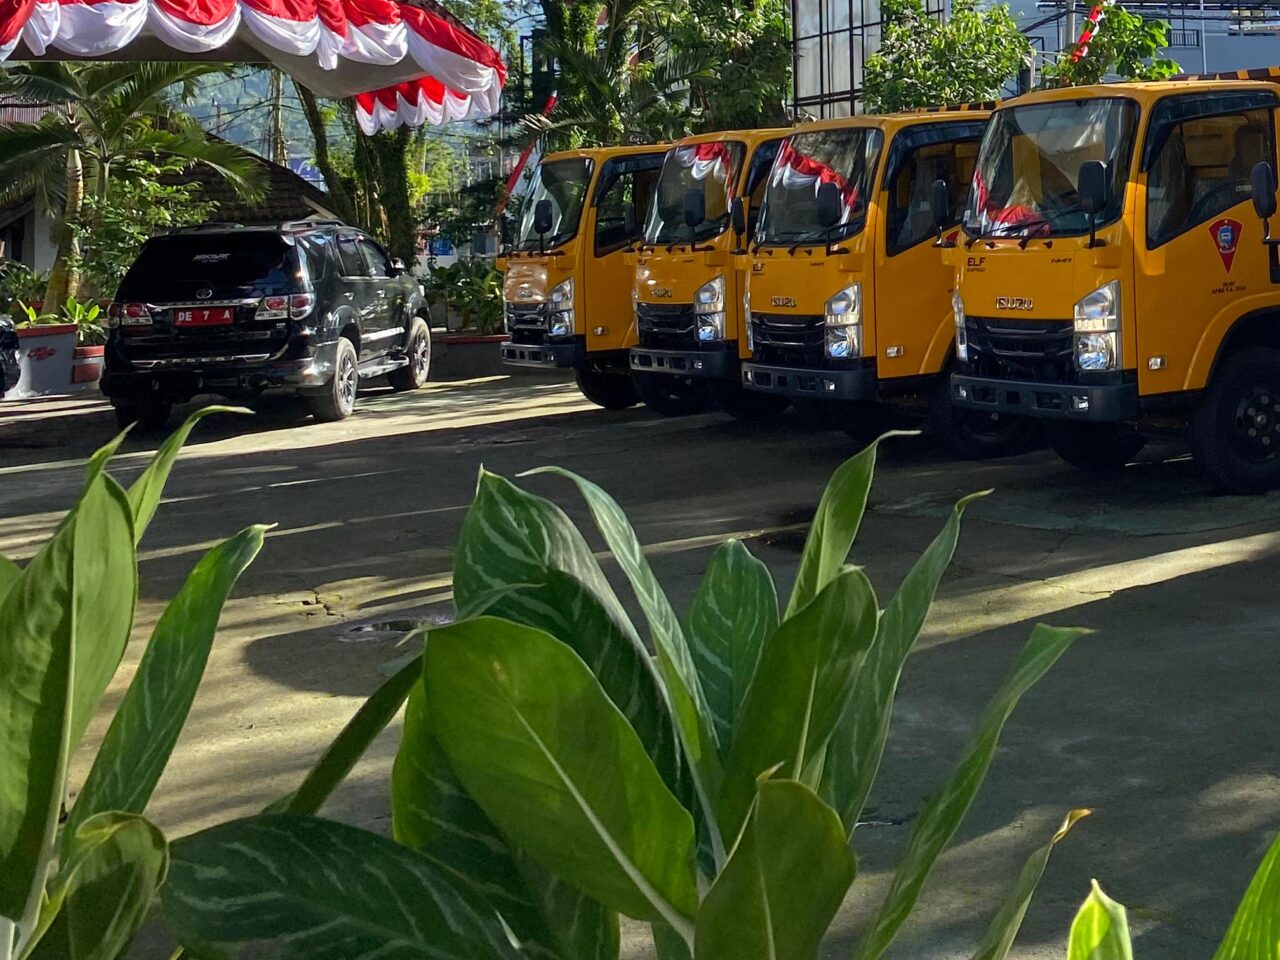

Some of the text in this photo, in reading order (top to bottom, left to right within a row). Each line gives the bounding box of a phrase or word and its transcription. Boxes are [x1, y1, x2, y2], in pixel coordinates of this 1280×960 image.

[967, 257, 986, 267] ELF
[996, 297, 1033, 310] ISUZU
[178, 309, 231, 321] DE 7 A
